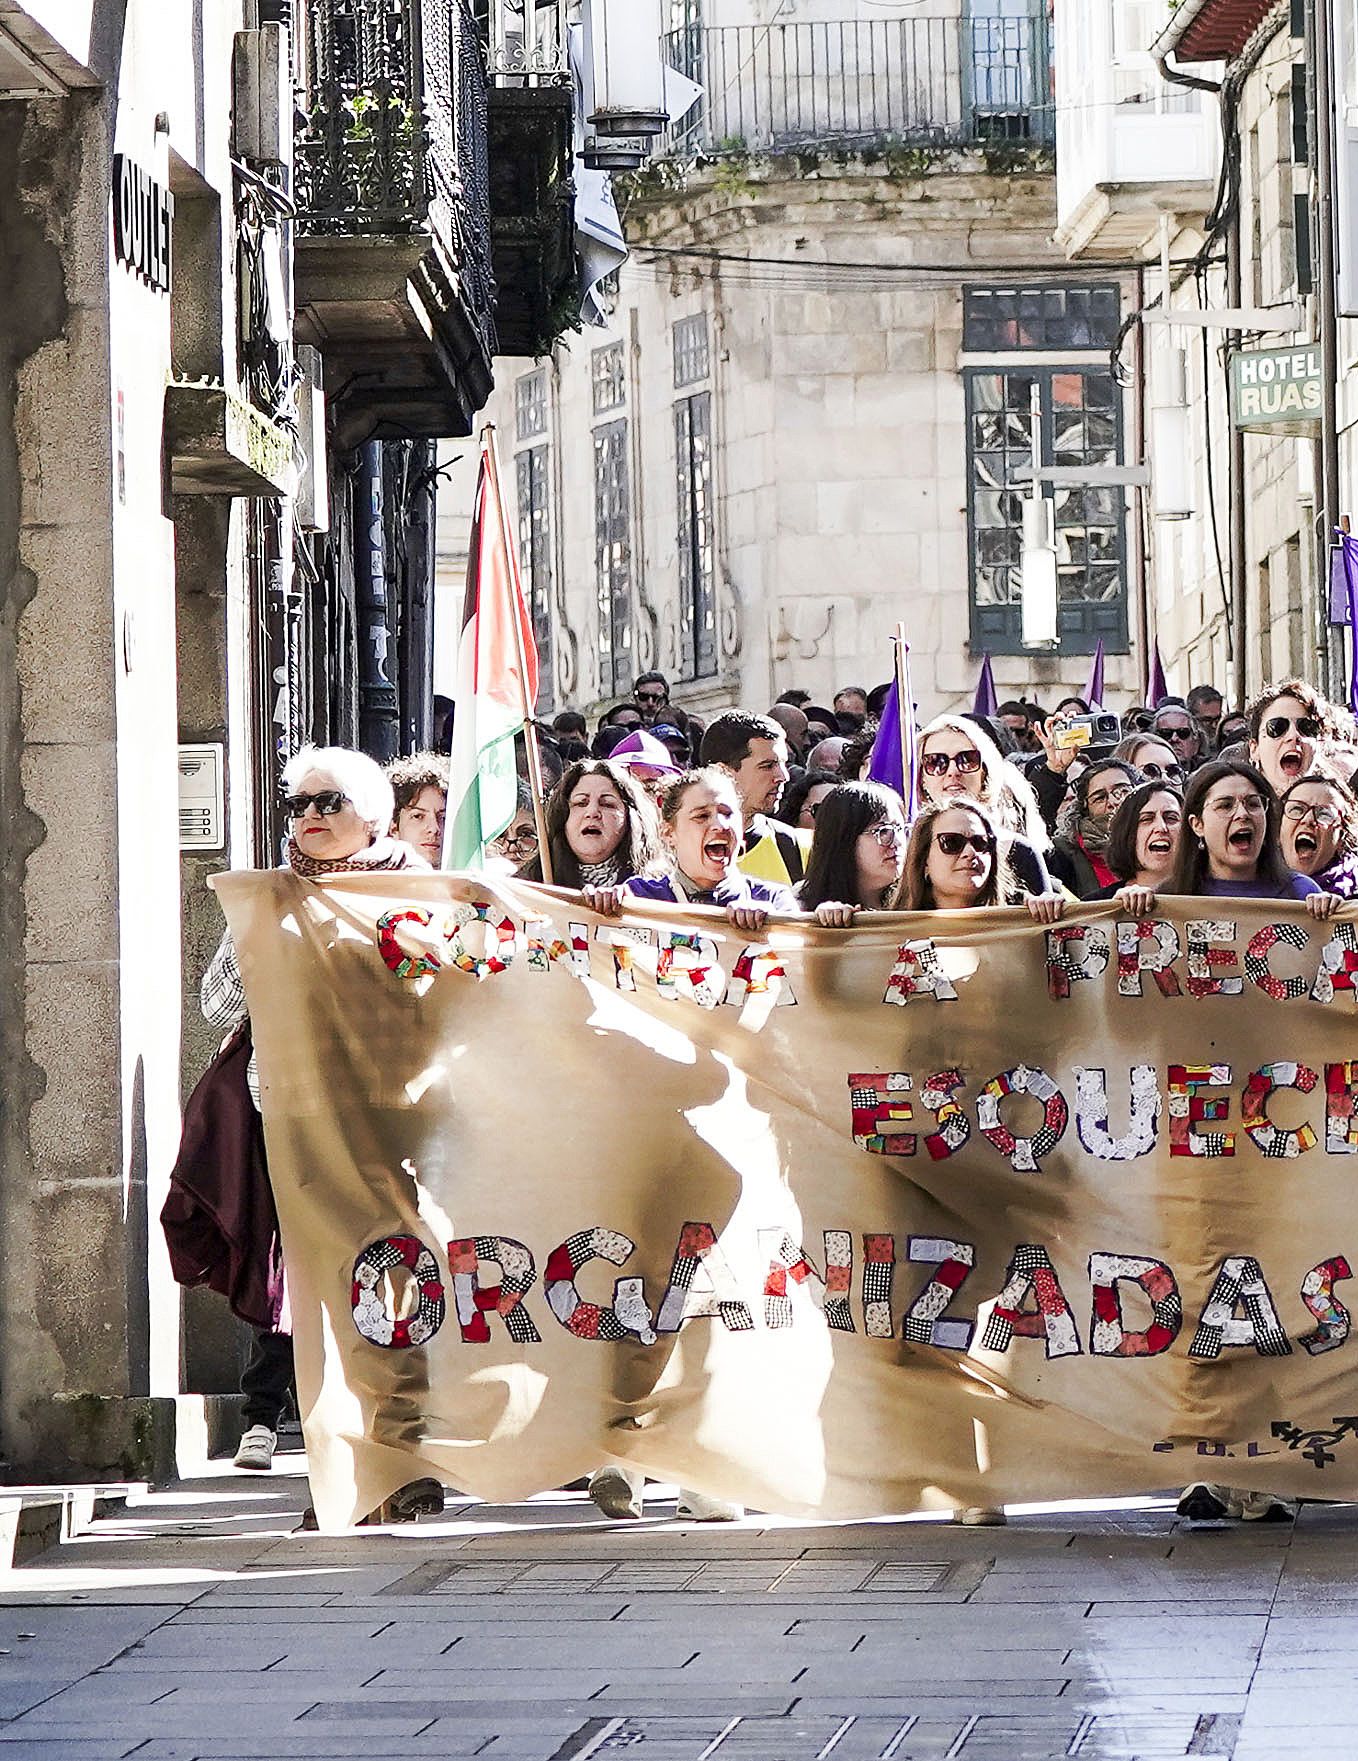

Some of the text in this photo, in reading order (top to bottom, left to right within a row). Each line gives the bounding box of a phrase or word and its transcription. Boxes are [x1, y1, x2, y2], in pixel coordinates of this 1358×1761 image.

[114, 153, 175, 294] OUTLET
[1240, 352, 1320, 385] HOTEL
[1240, 380, 1321, 417] RUAS
[377, 902, 800, 1009] CONTRA
[882, 936, 959, 1007] A
[352, 1221, 1353, 1358] ORGANIZADAS
